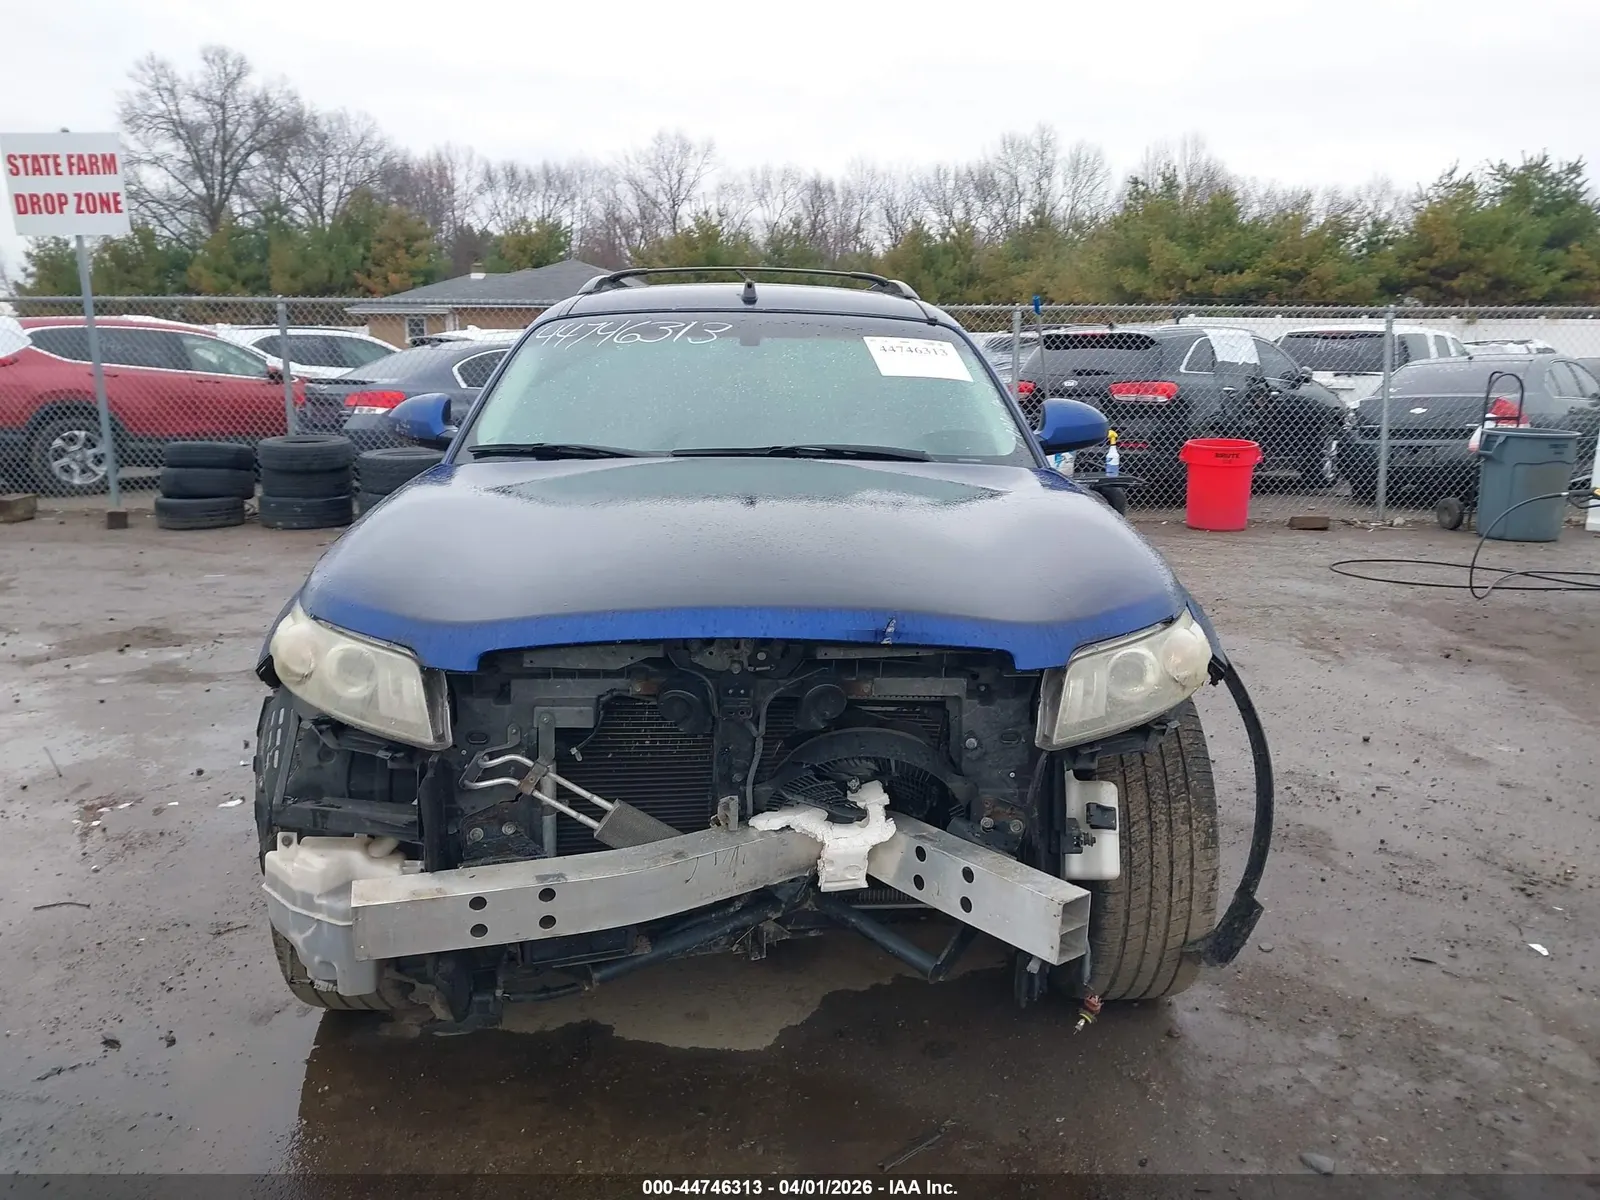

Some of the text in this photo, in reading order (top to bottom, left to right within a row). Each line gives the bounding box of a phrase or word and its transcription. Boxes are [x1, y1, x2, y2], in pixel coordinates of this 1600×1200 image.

[6, 153, 118, 176] STATE FARM
[13, 191, 124, 215] DROP ZONE
[535, 319, 733, 350] 44746313
[879, 345, 948, 357] 44746313
